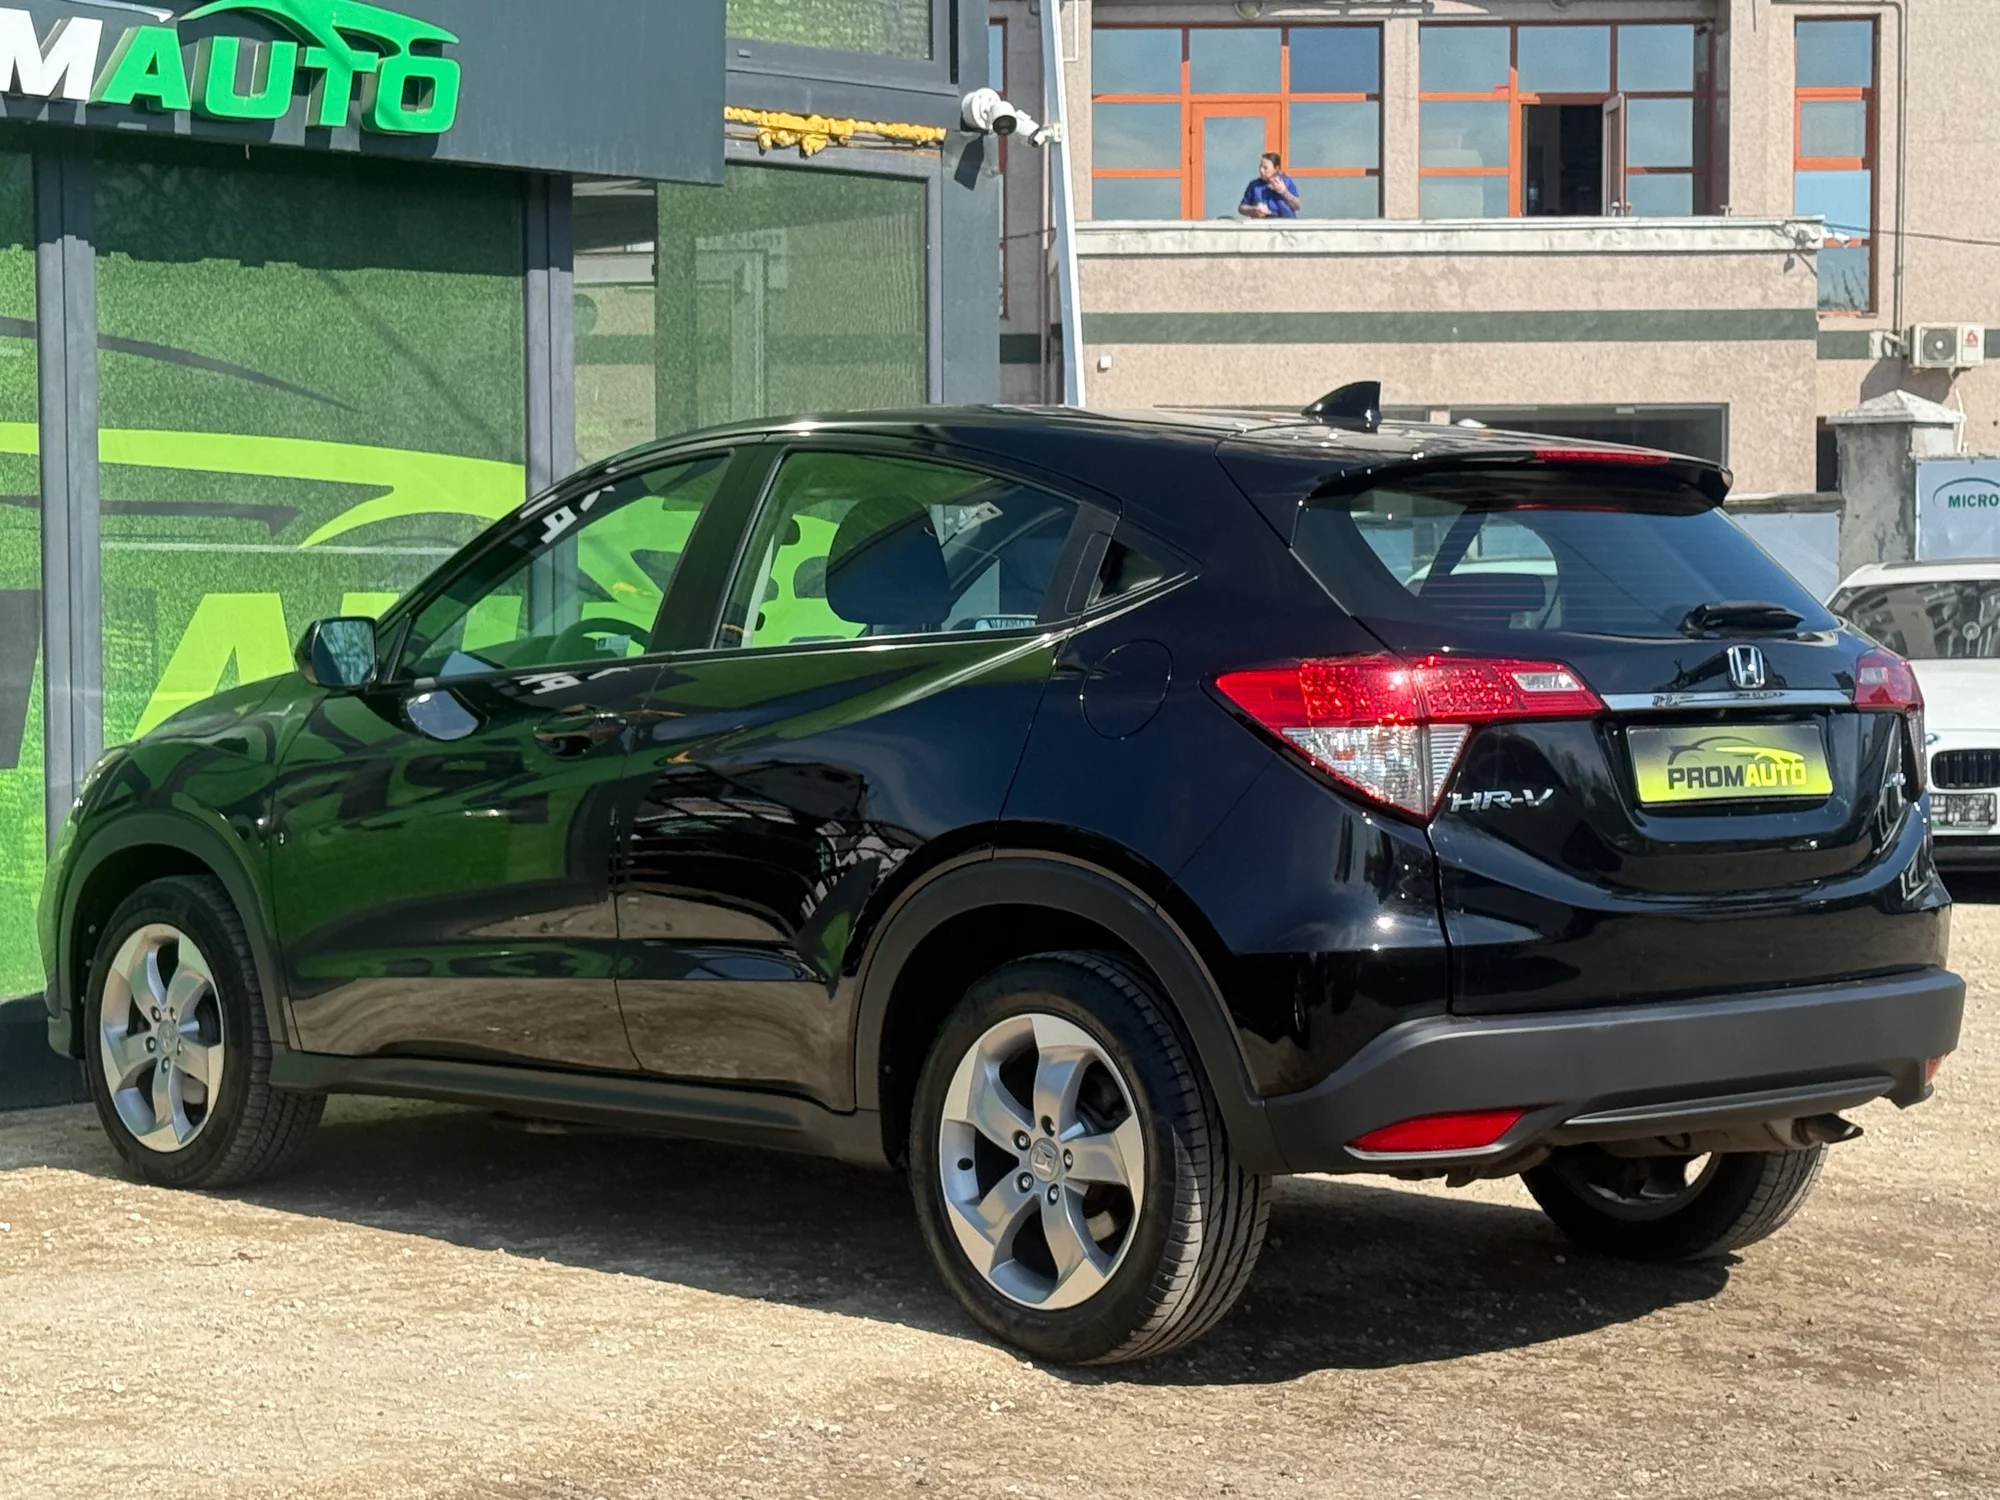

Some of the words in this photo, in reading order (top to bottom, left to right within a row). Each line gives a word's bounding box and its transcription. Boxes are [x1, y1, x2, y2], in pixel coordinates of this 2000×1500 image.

[1948, 493, 2000, 508] MICRO
[1667, 763, 1807, 789] PROMAUTO
[1450, 788, 1554, 812] HR-V
